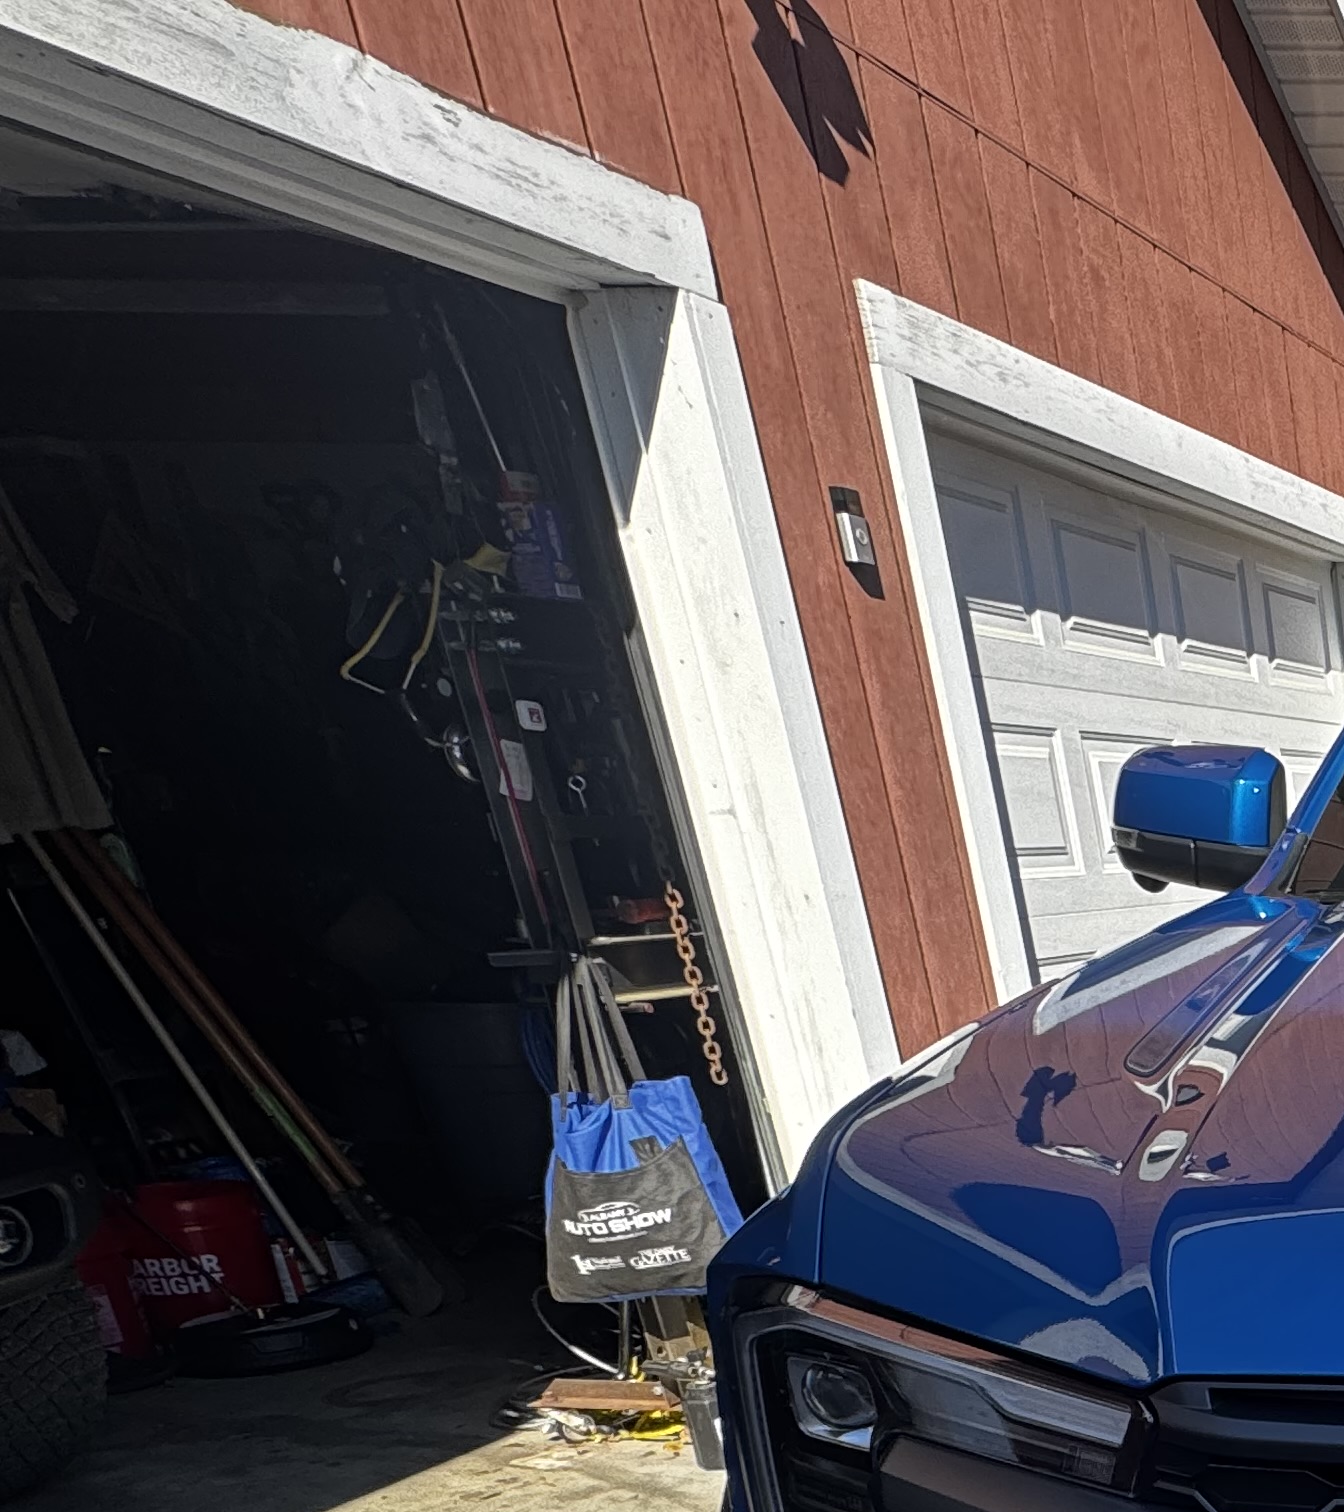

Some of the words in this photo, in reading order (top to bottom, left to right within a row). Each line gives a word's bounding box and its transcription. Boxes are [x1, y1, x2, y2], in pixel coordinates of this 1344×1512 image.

[562, 1219, 608, 1237] AUTO
[608, 1208, 672, 1233] SHOW
[130, 1254, 223, 1277] ARBOR
[128, 1272, 226, 1297] REIGHT
